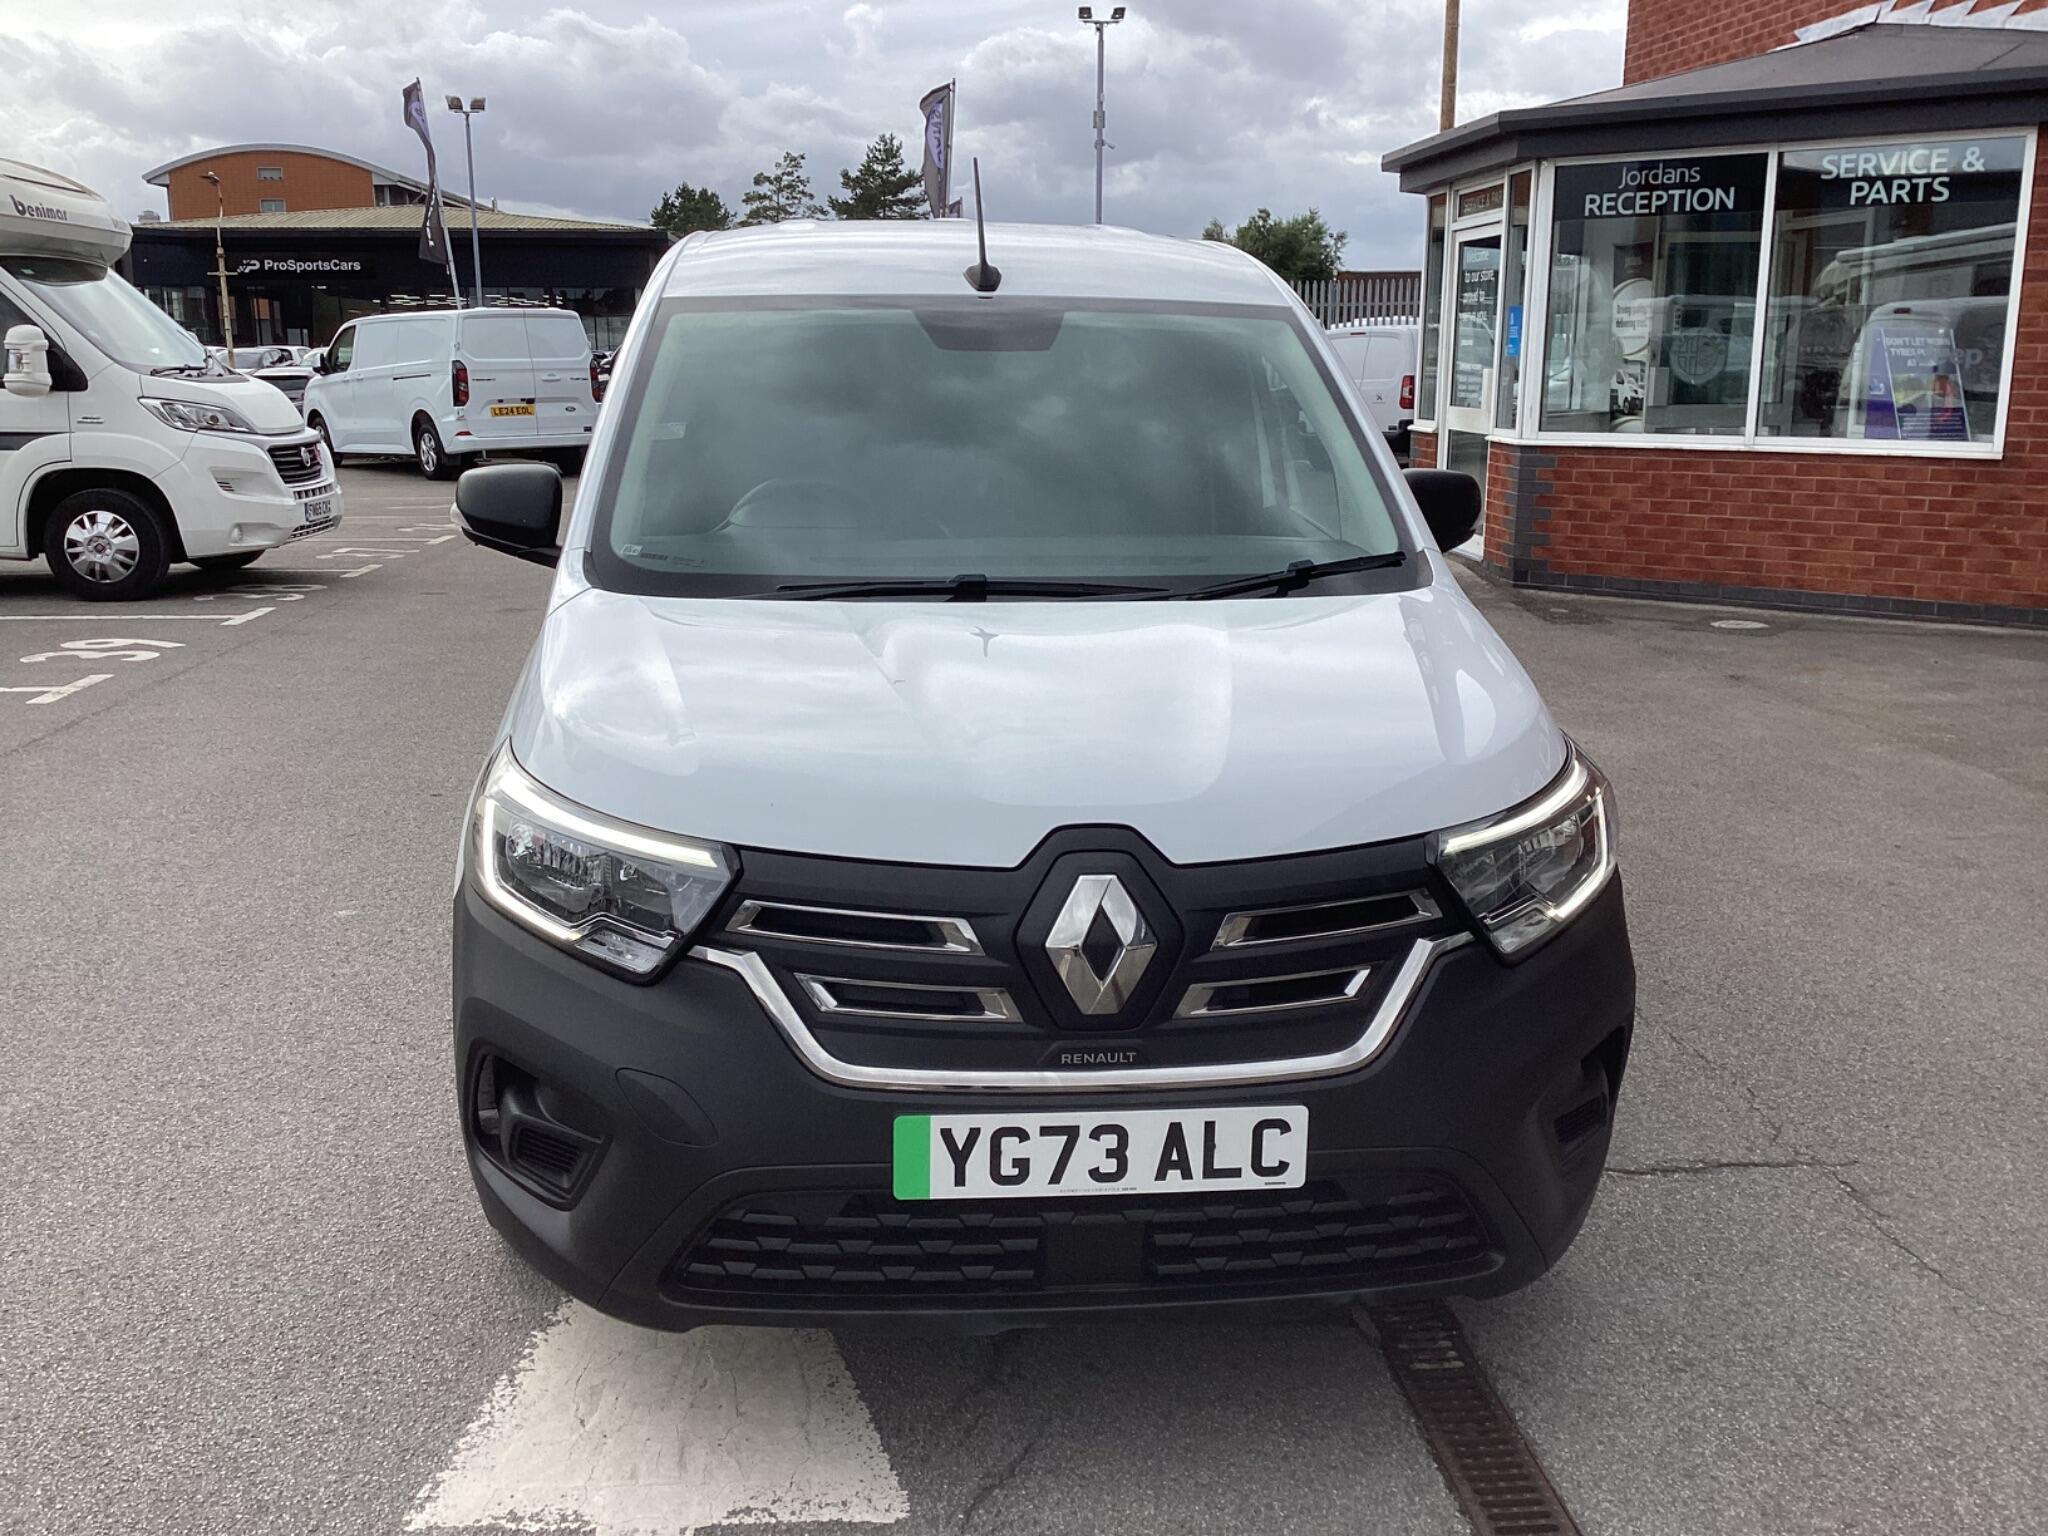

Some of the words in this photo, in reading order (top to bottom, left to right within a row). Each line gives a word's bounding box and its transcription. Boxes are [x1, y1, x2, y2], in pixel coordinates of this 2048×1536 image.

[1618, 162, 1701, 189] Jordans
[1820, 148, 1949, 180] SERVICE
[1961, 146, 1986, 172] &
[1584, 187, 1735, 217] RECEPTION
[1849, 177, 1950, 206] PARTS
[264, 259, 362, 273] ProSportsCars
[1061, 1052, 1137, 1065] RENAULT
[940, 1122, 1130, 1187] YG73
[1153, 1118, 1292, 1182] ALC
